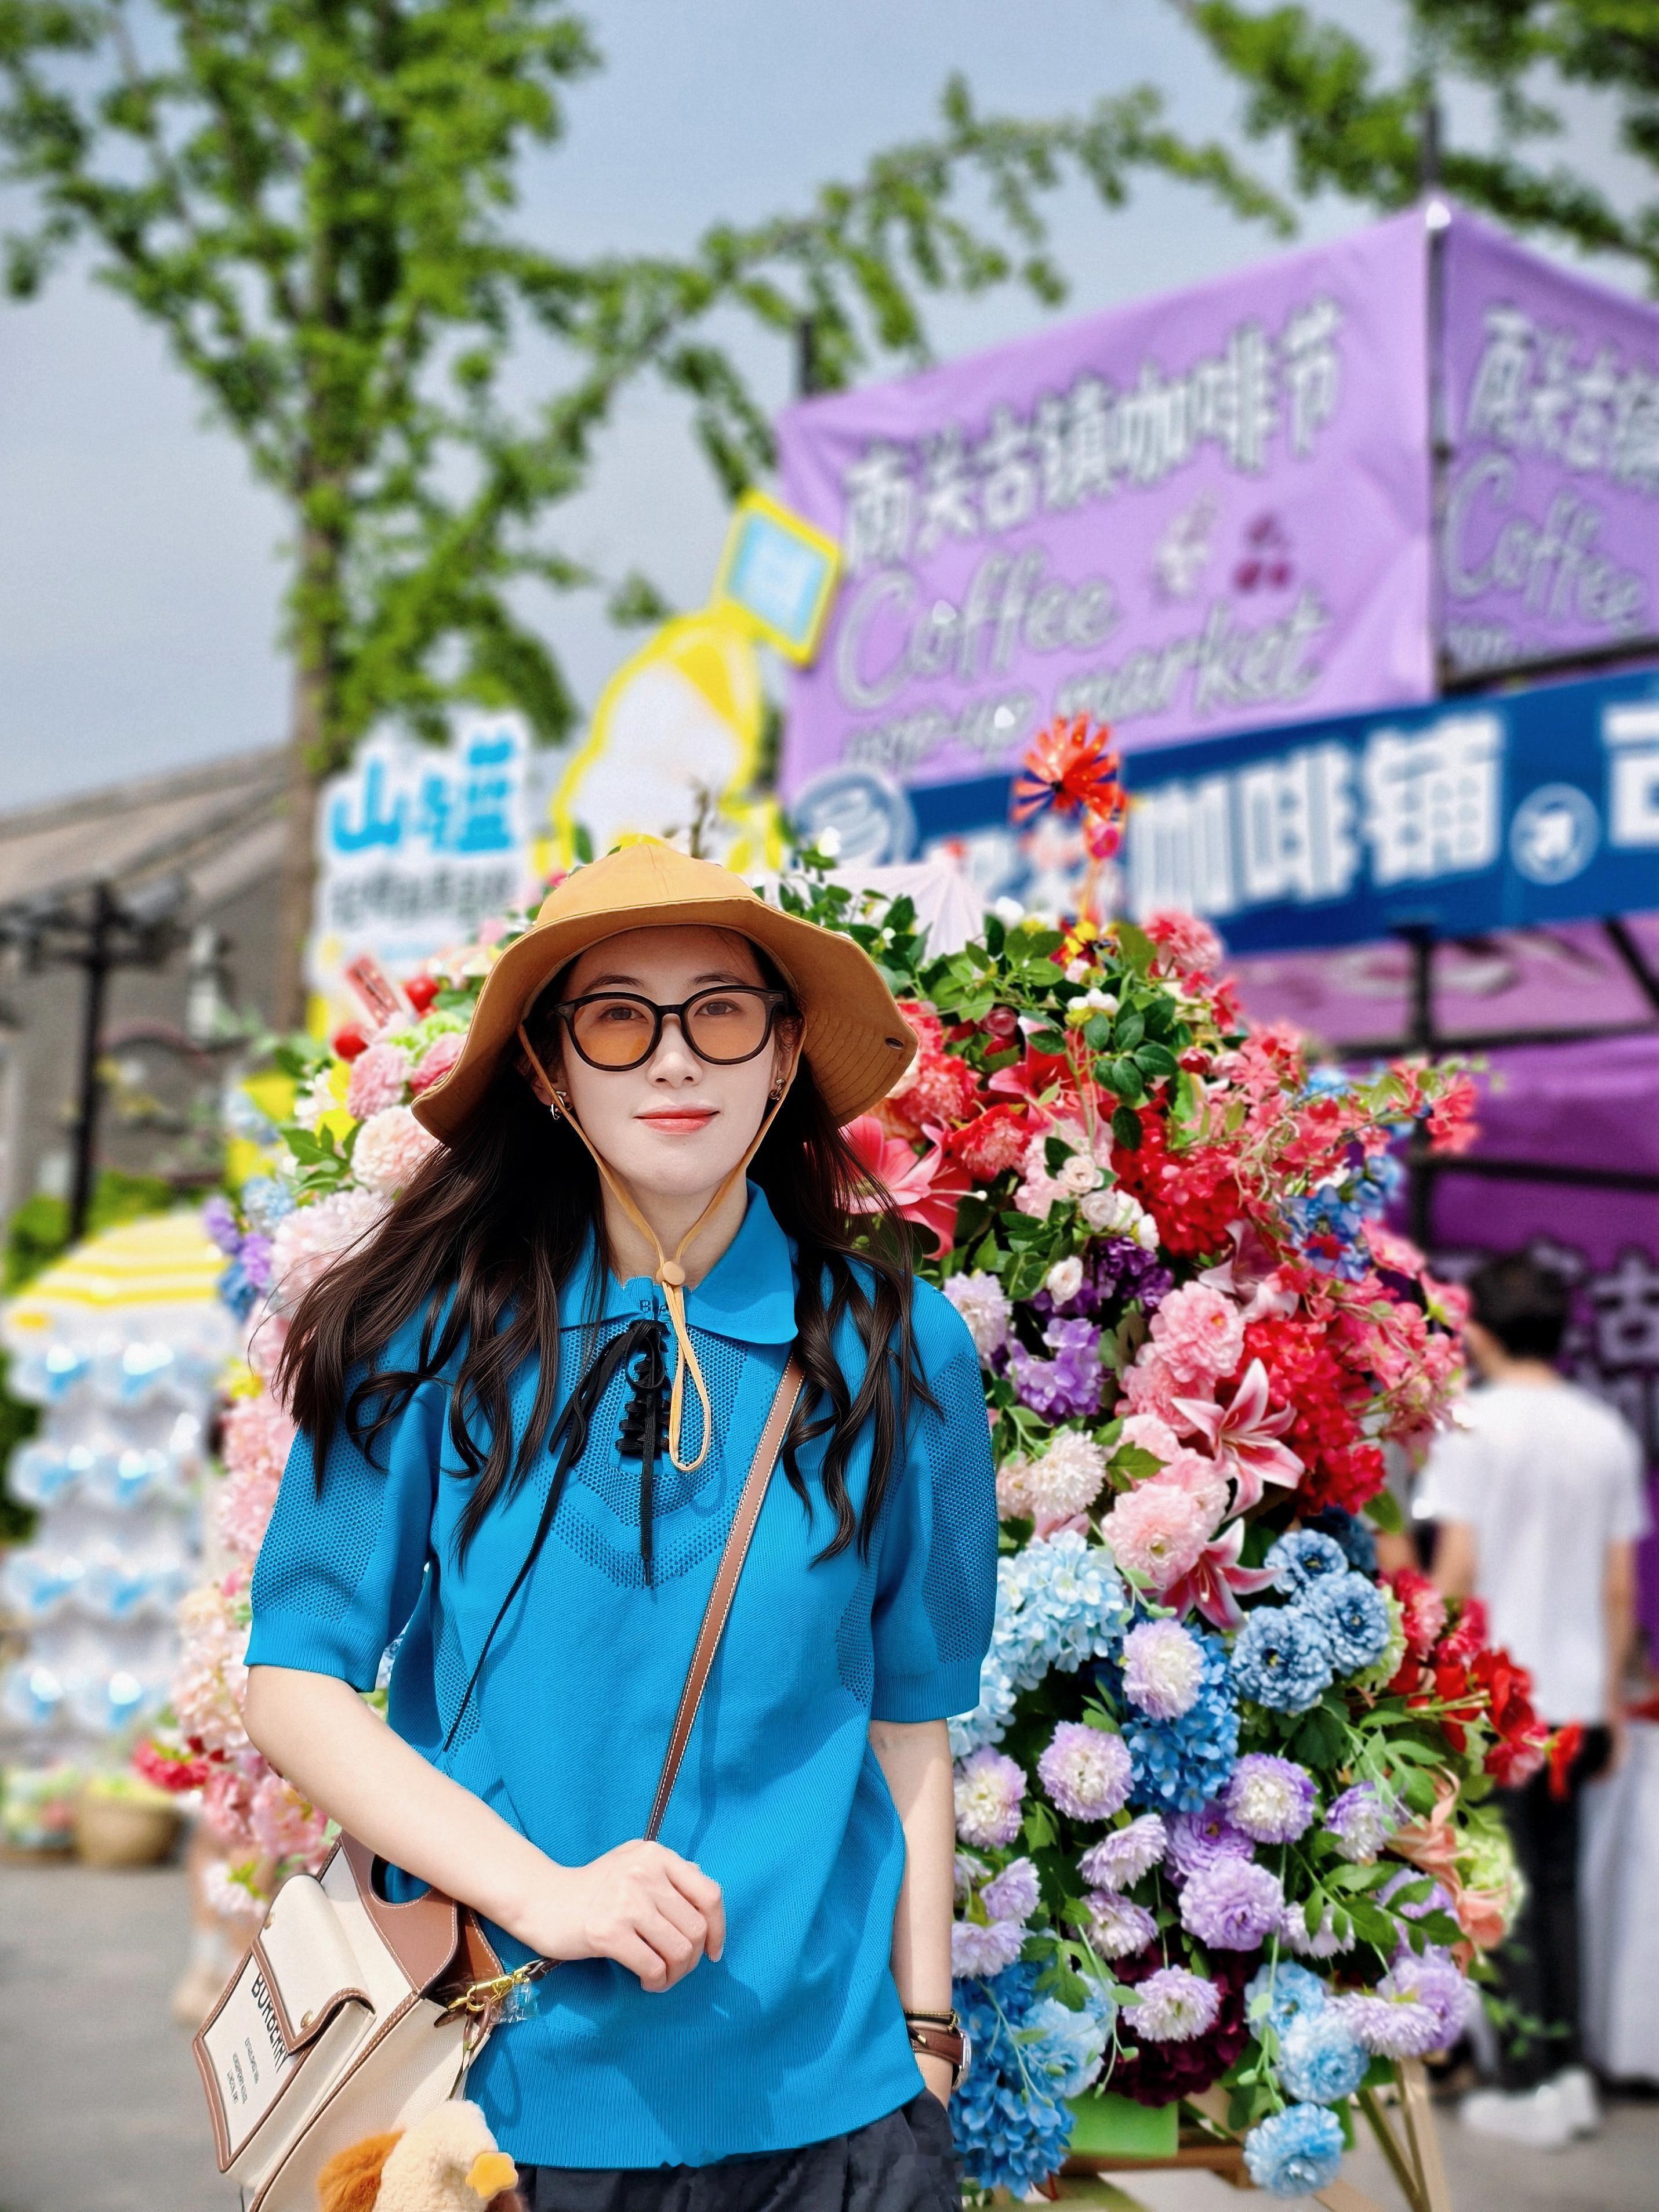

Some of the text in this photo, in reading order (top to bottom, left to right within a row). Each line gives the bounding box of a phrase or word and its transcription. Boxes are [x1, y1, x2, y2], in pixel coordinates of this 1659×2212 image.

[1445, 449, 1647, 632] Coffee
[836, 548, 1116, 709] Coffee
[1052, 586, 1328, 722] market
